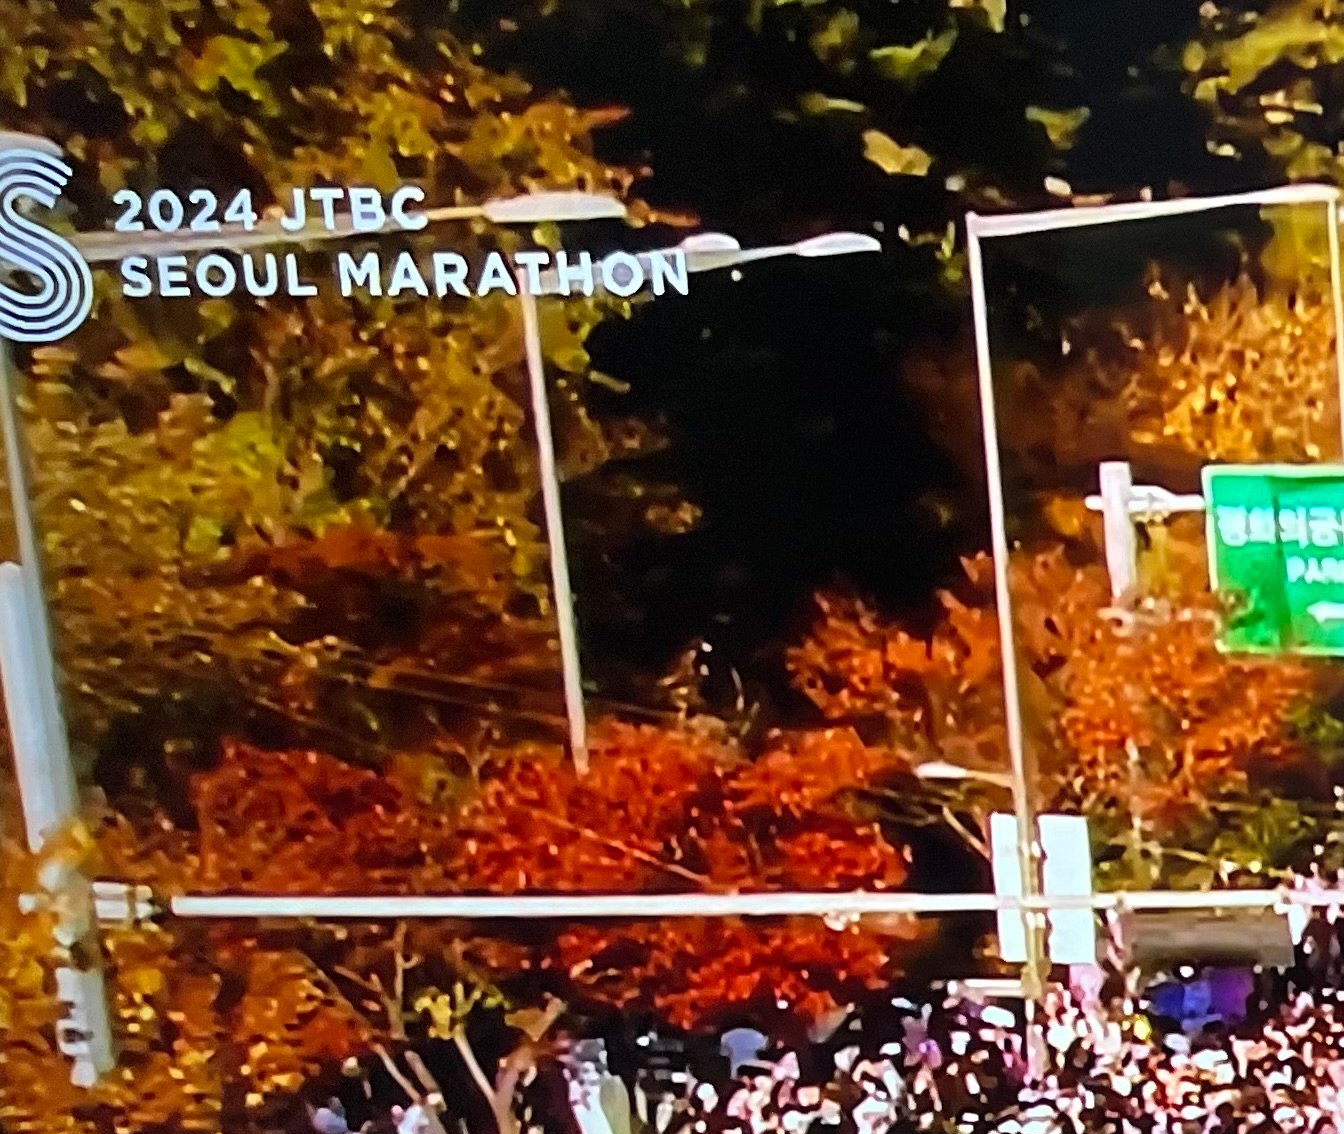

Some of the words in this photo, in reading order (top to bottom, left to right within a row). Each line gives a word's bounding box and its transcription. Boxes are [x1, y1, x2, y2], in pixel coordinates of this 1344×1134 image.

[113, 188, 258, 233] 2024
[280, 186, 428, 232] JTBC
[121, 255, 318, 299] SEOUL
[338, 251, 690, 298] MARATHON
